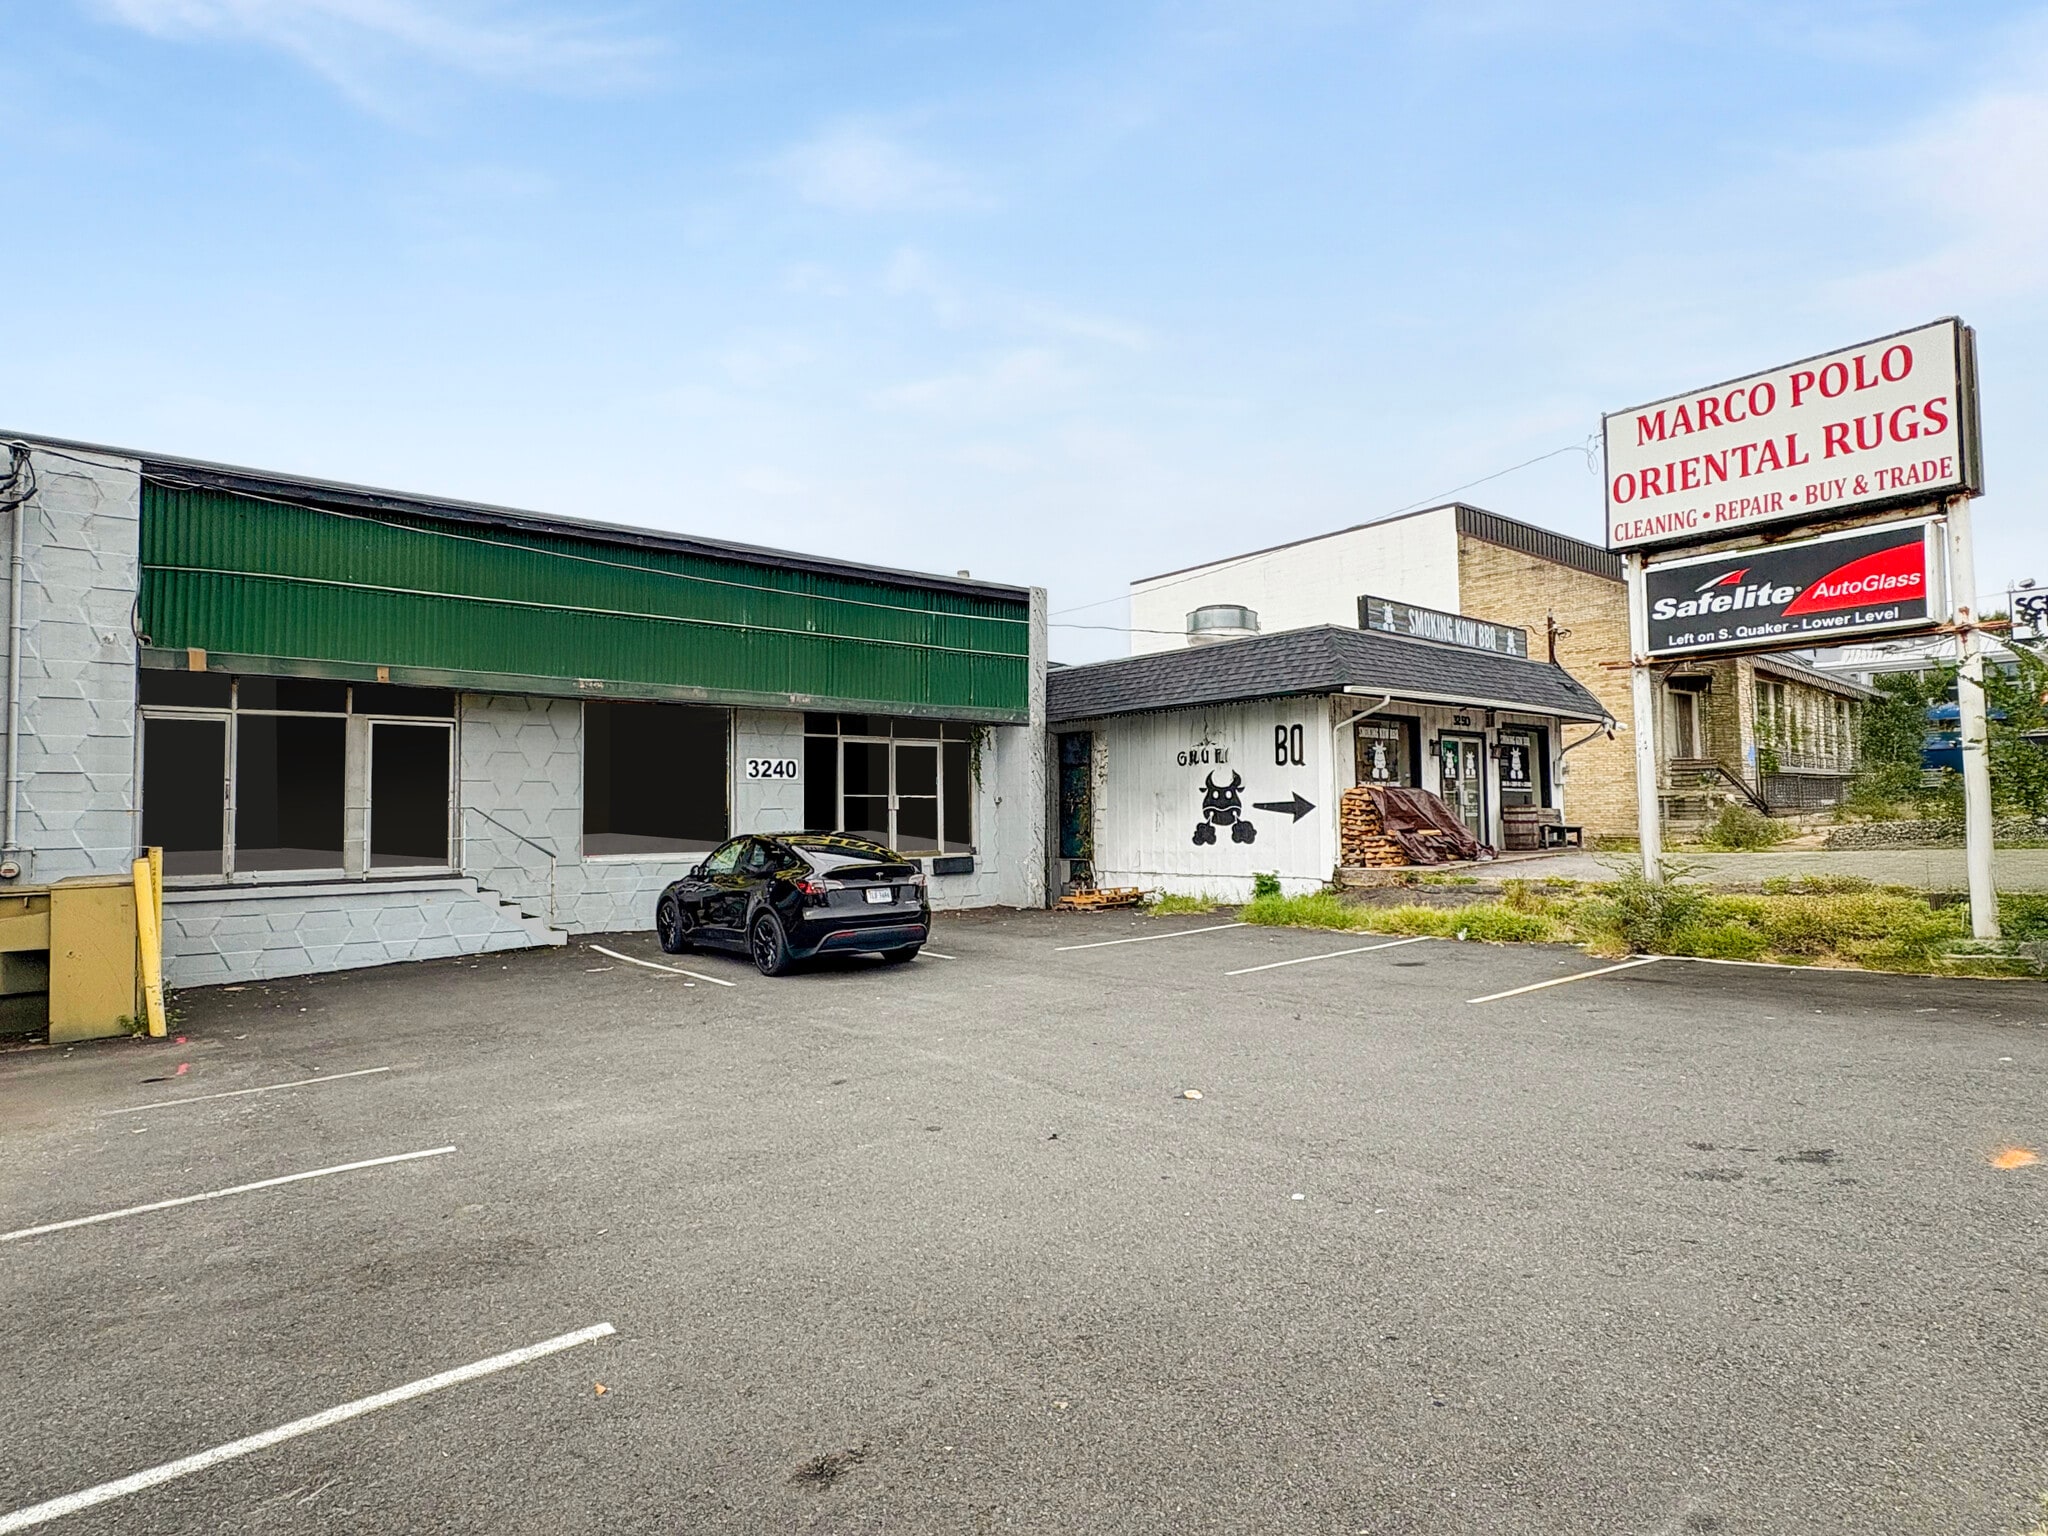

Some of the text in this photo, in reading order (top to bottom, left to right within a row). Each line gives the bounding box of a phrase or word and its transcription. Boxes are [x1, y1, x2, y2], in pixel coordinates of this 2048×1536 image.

[1636, 344, 1914, 447] MARCO POLO
[1613, 397, 1949, 504] ORIENTAL RUGS
[1614, 456, 1954, 542] CLEANING REPAIR BUY & TRADE
[1652, 581, 1796, 621] Safelite
[1812, 571, 1922, 600] AutoGlass
[1408, 608, 1497, 651] SMOKING KOW BBQ
[1668, 632, 1695, 647] Left
[1697, 632, 1715, 643] on
[1718, 627, 1732, 641] S.
[1736, 621, 1788, 639] Quaker
[1802, 614, 1851, 631] Lower
[1855, 606, 1899, 624] Level
[1274, 723, 1306, 767] BQ
[748, 759, 797, 778] 3240
